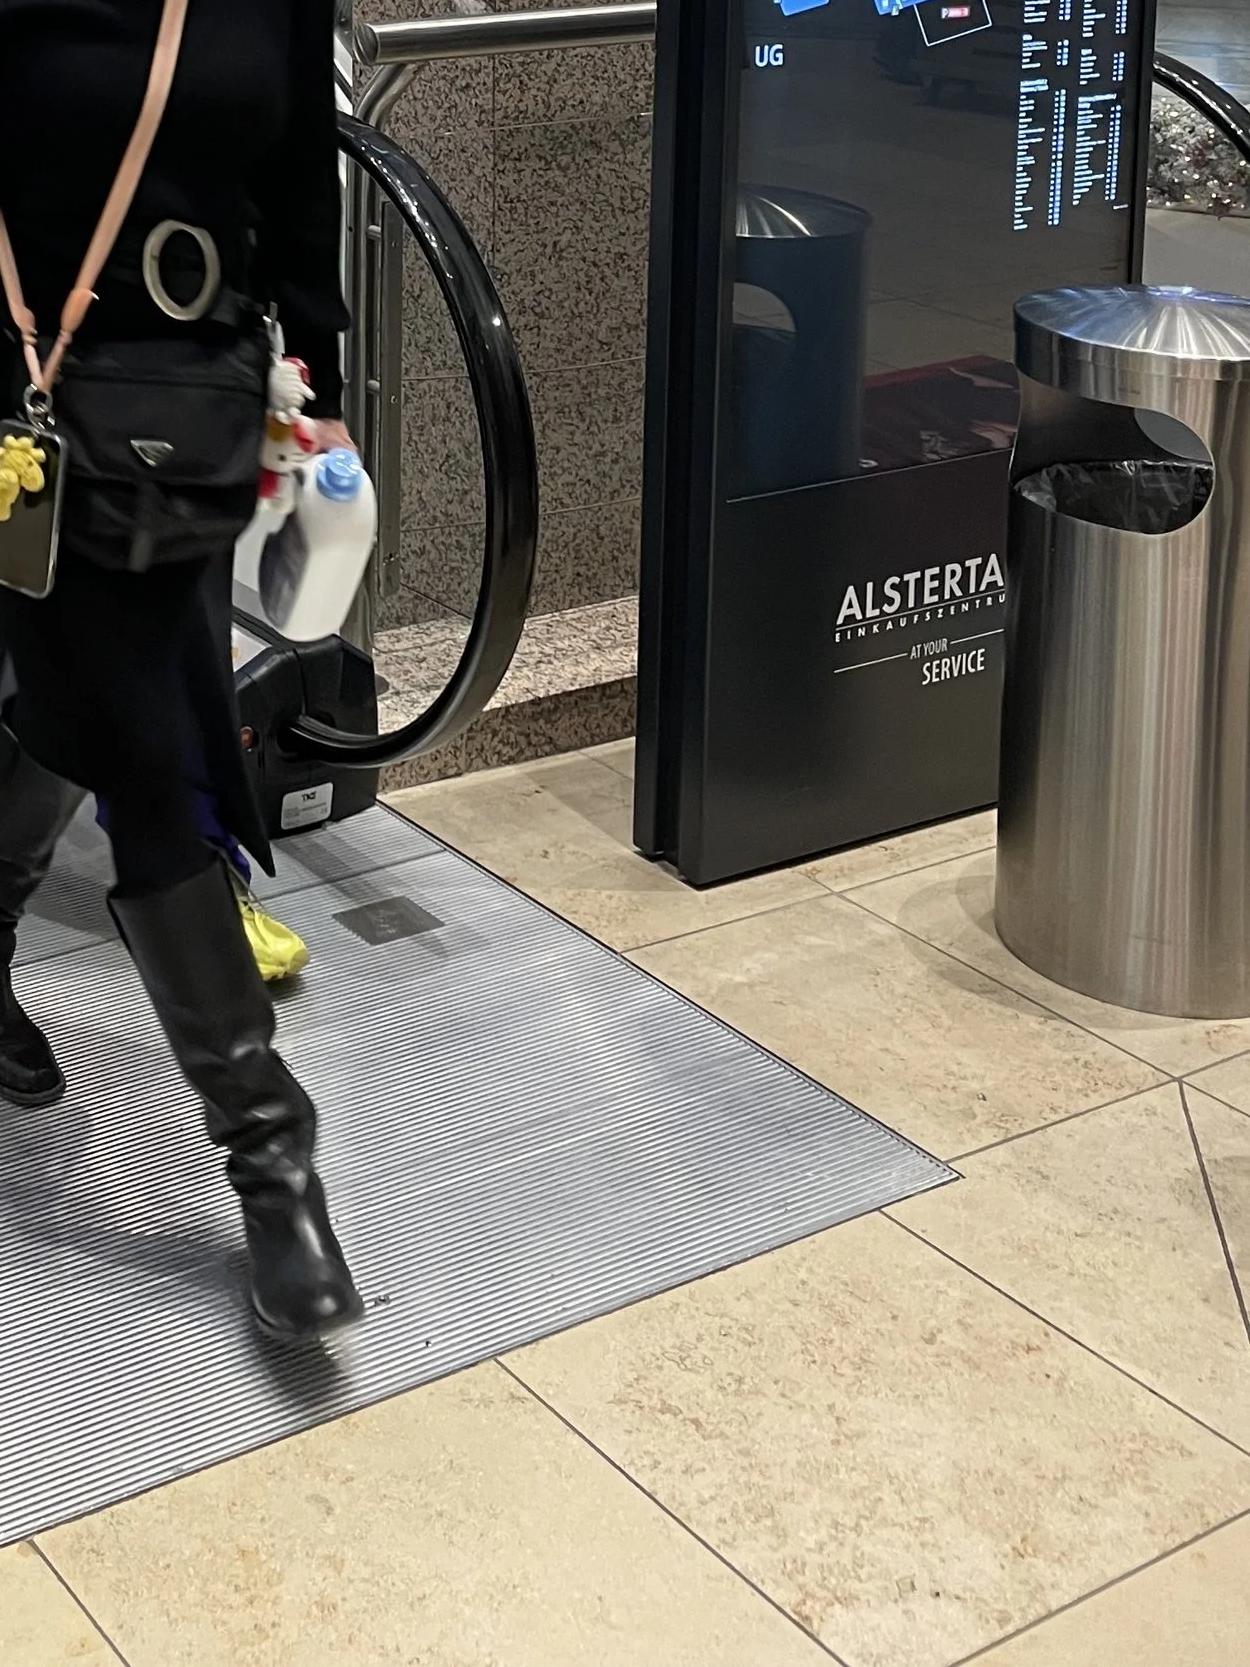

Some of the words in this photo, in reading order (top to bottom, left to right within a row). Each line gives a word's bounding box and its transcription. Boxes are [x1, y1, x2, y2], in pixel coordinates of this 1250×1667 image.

[754, 44, 784, 67] UG
[836, 553, 1005, 626] ALSTERTA
[910, 643, 923, 661] AT
[924, 637, 948, 656] YOUR
[921, 648, 986, 686] SERVICE
